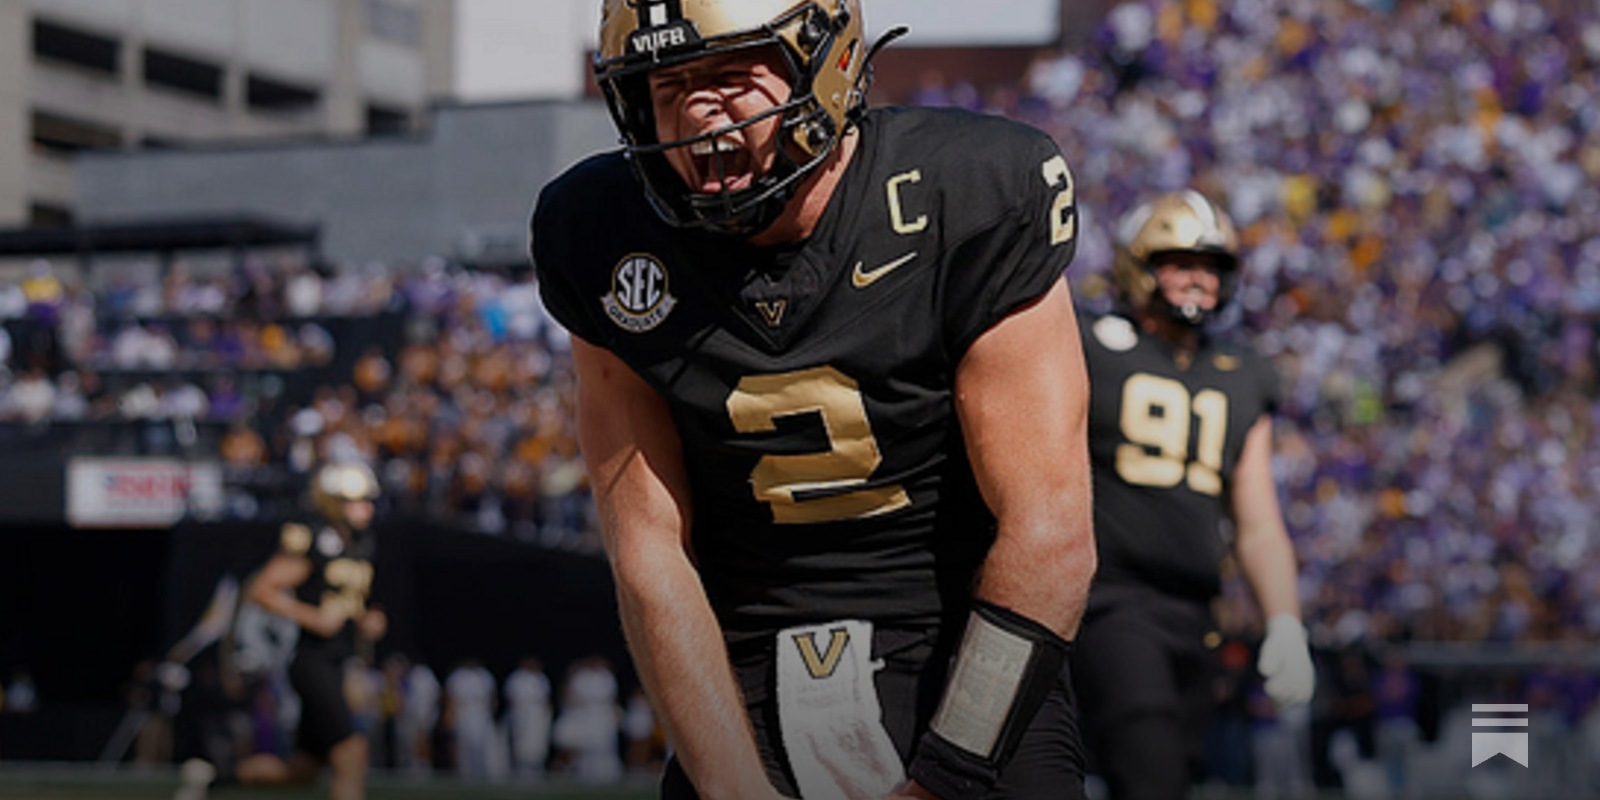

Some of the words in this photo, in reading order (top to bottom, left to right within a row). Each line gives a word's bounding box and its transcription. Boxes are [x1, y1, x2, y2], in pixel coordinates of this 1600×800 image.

[886, 169, 927, 234] C
[1042, 155, 1074, 247] 2
[616, 258, 663, 311] SEC
[755, 300, 786, 327] V
[726, 364, 912, 524] 2
[1115, 372, 1229, 497] 91
[792, 626, 850, 680] V
